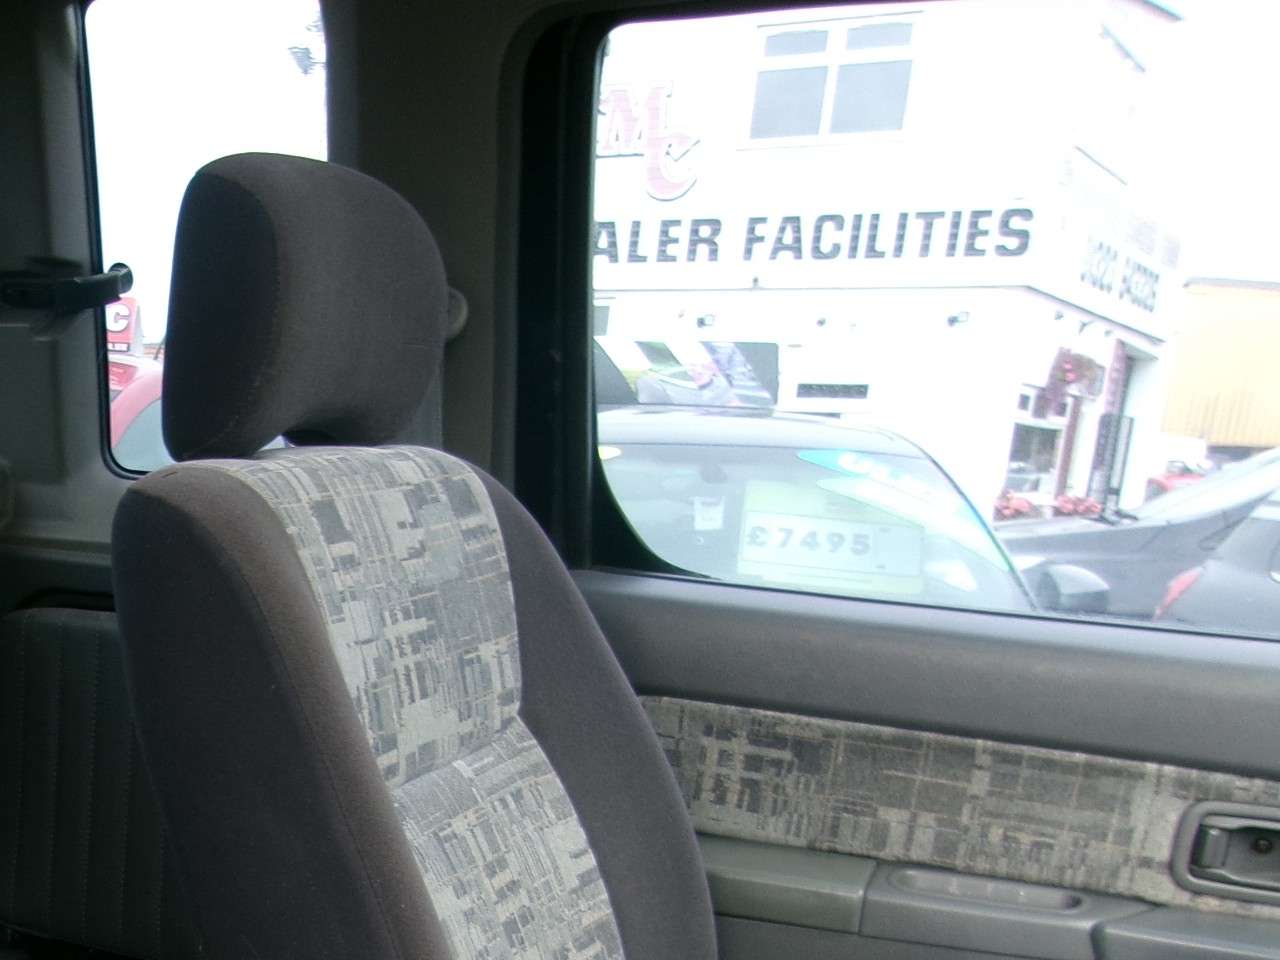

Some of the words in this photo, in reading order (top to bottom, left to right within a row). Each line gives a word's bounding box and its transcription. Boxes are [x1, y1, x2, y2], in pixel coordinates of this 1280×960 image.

[593, 218, 722, 264] ALER
[743, 208, 1034, 262] FACILITIES
[745, 525, 871, 556] £7495
